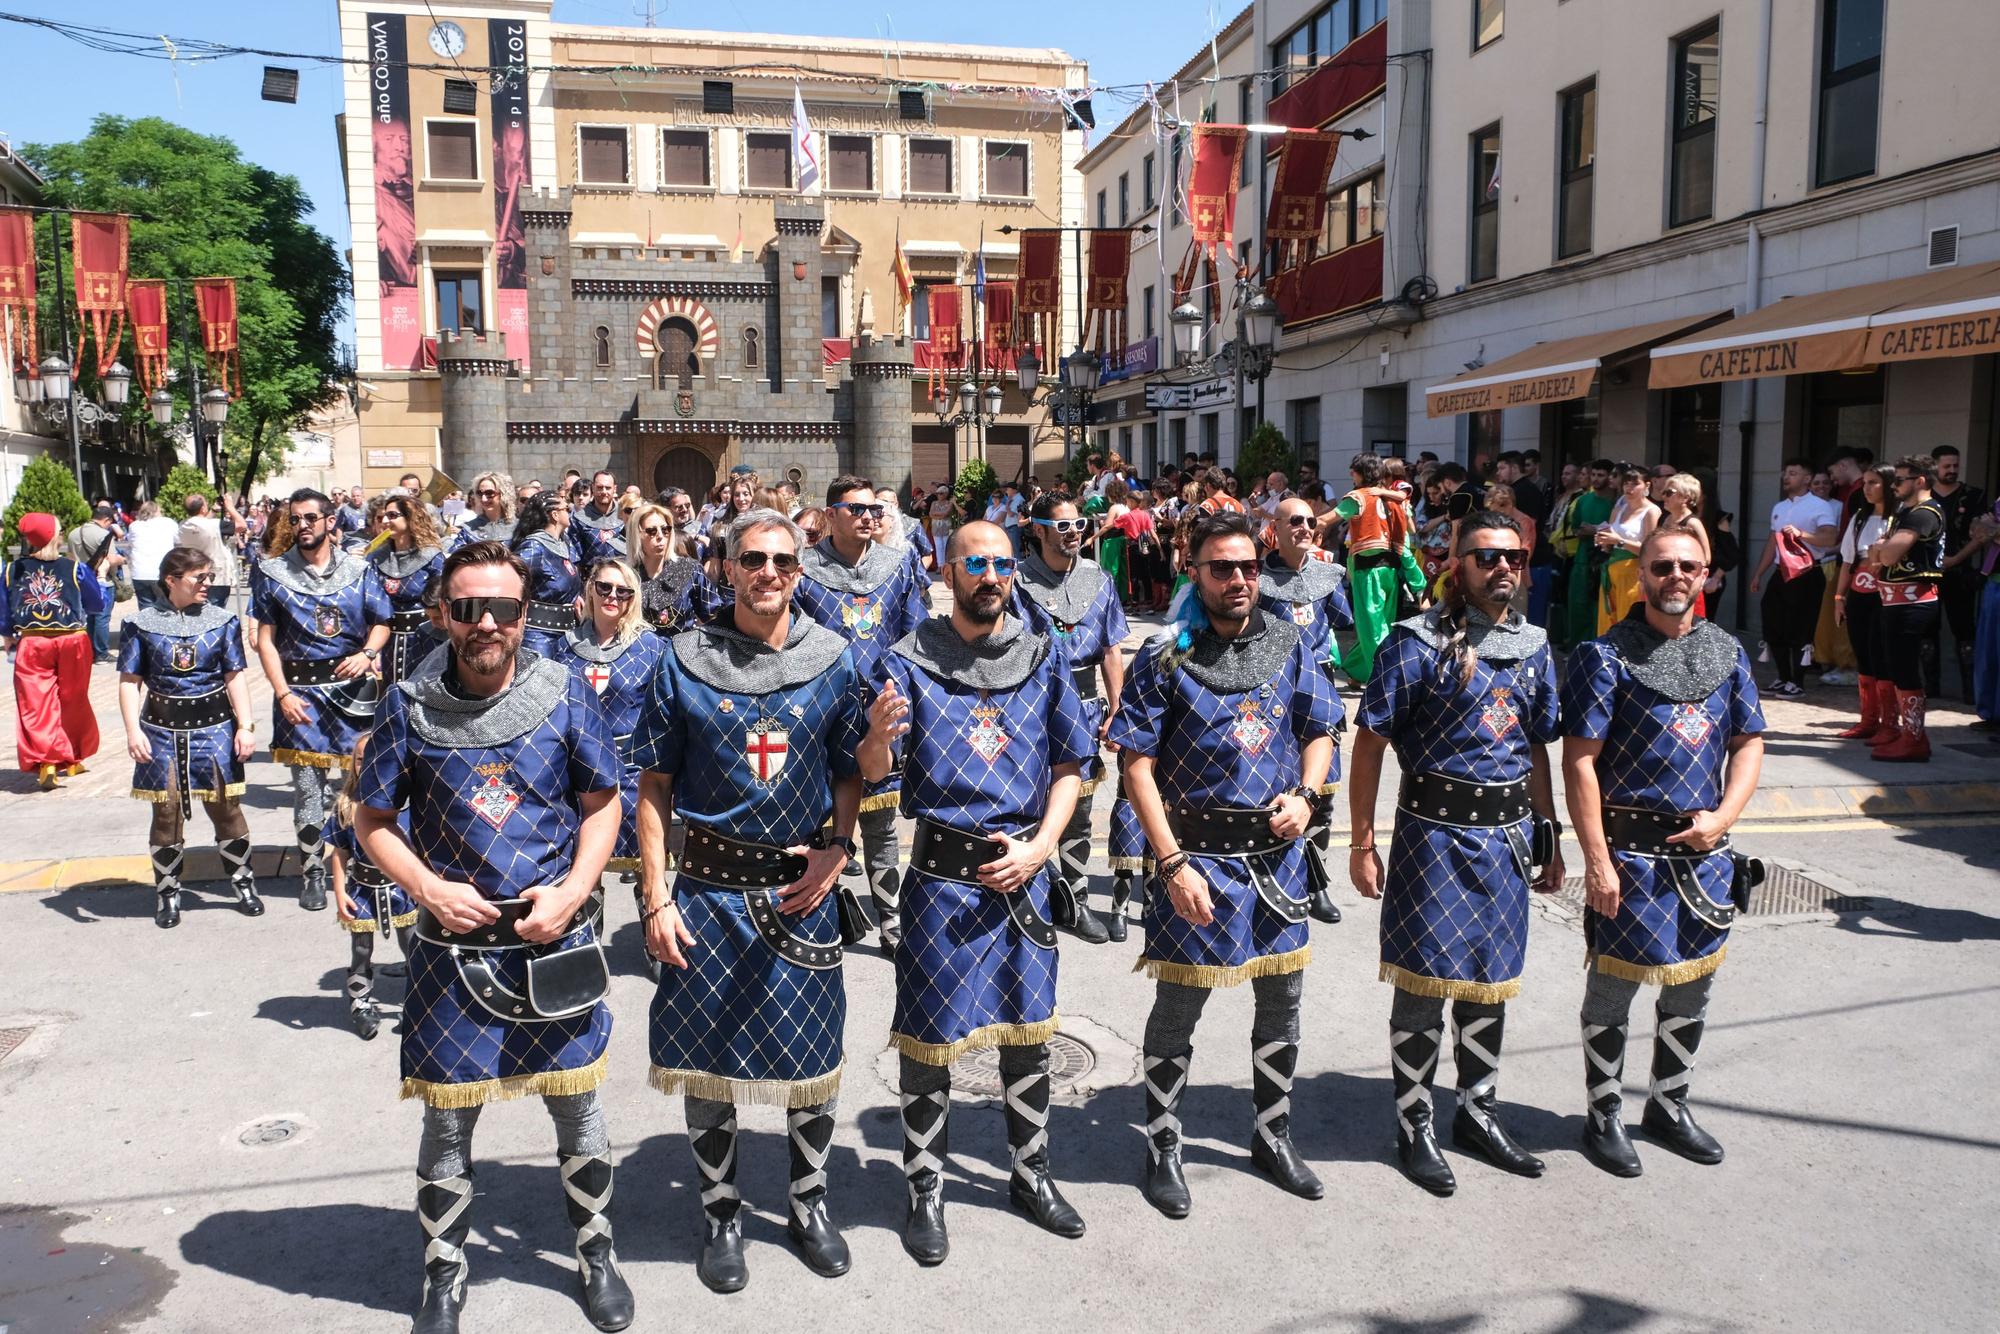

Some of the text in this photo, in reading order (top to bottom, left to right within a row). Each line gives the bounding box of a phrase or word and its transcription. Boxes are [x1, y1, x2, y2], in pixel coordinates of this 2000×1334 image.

[376, 93, 391, 124] año
[1700, 341, 1799, 379] CAFETIN
[1436, 389, 1492, 414] CAFETERIA
[1507, 375, 1576, 404] HELADERIA
